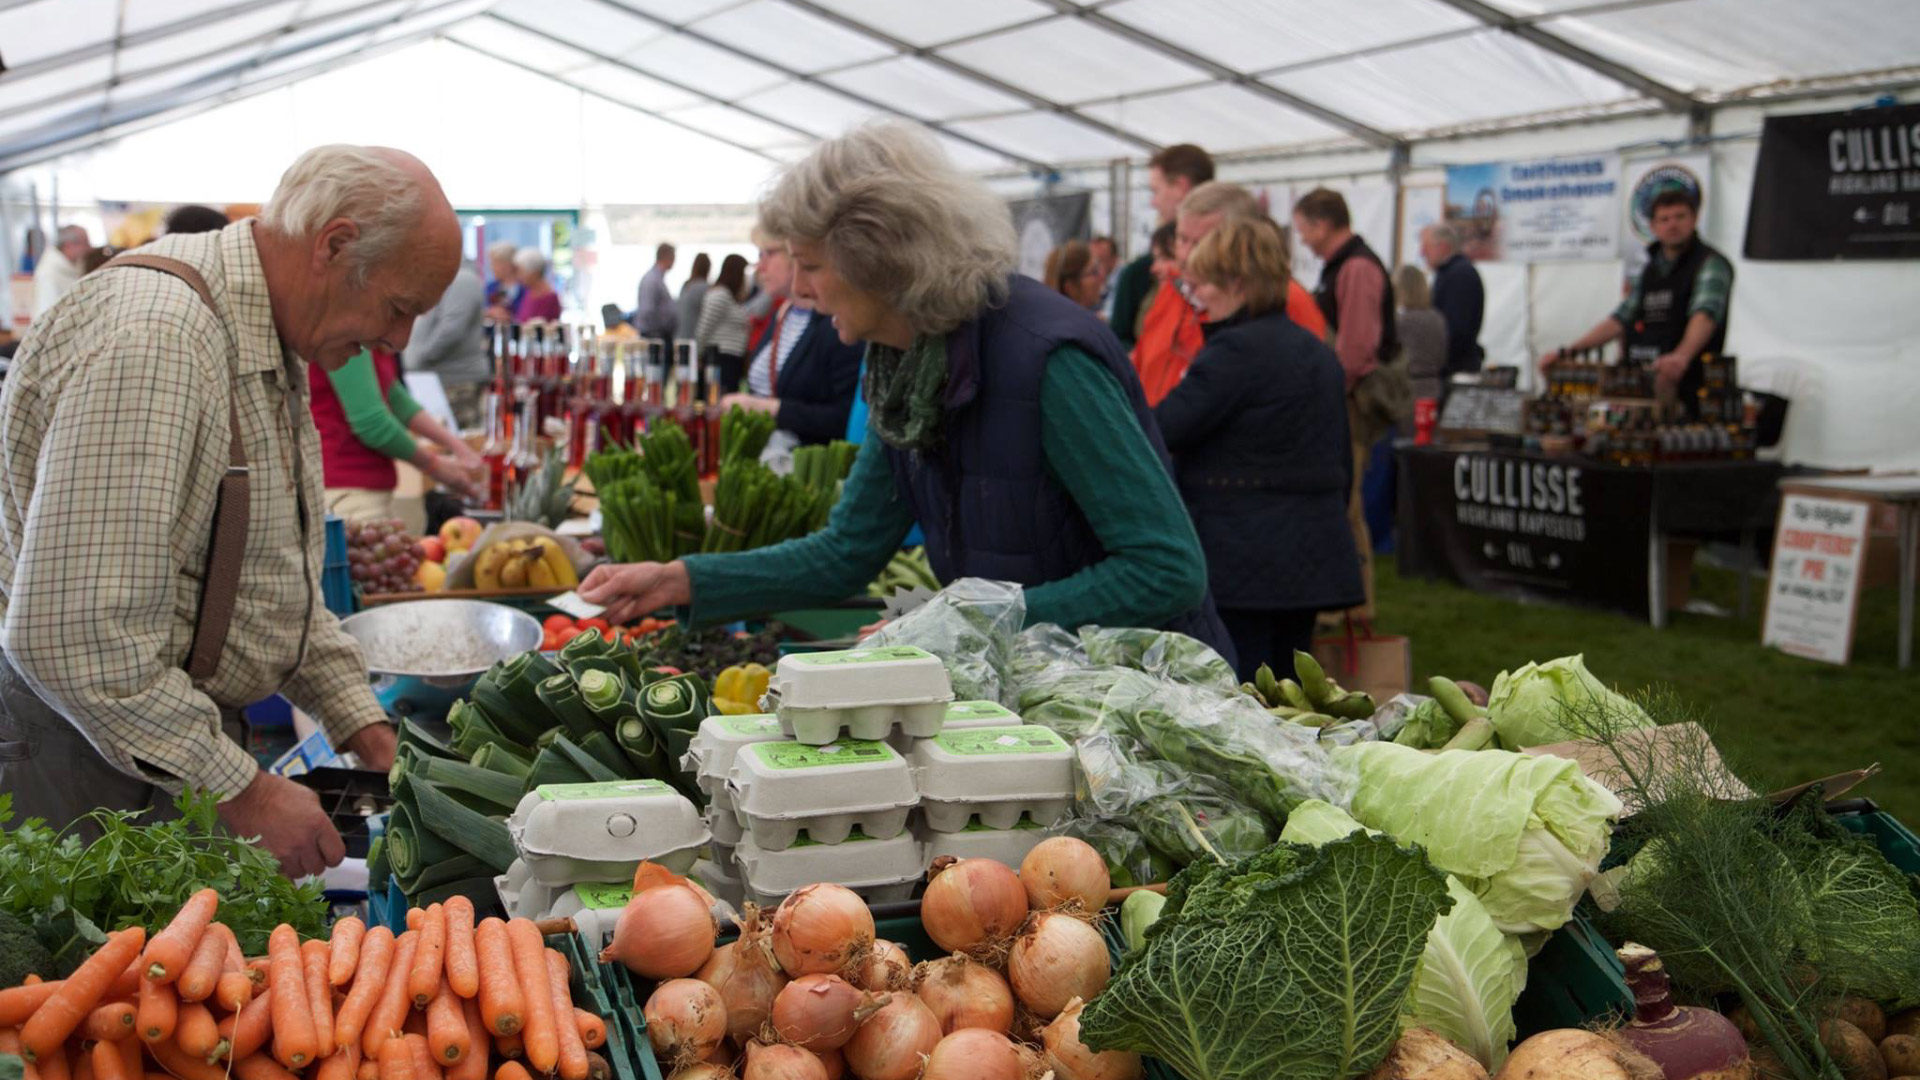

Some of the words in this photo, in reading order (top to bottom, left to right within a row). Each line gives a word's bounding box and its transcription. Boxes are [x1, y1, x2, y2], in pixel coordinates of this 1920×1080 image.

[1454, 454, 1584, 516] CULLISSE
[1456, 502, 1517, 532] HIGHLAND
[1518, 509, 1586, 541] RAPESEED
